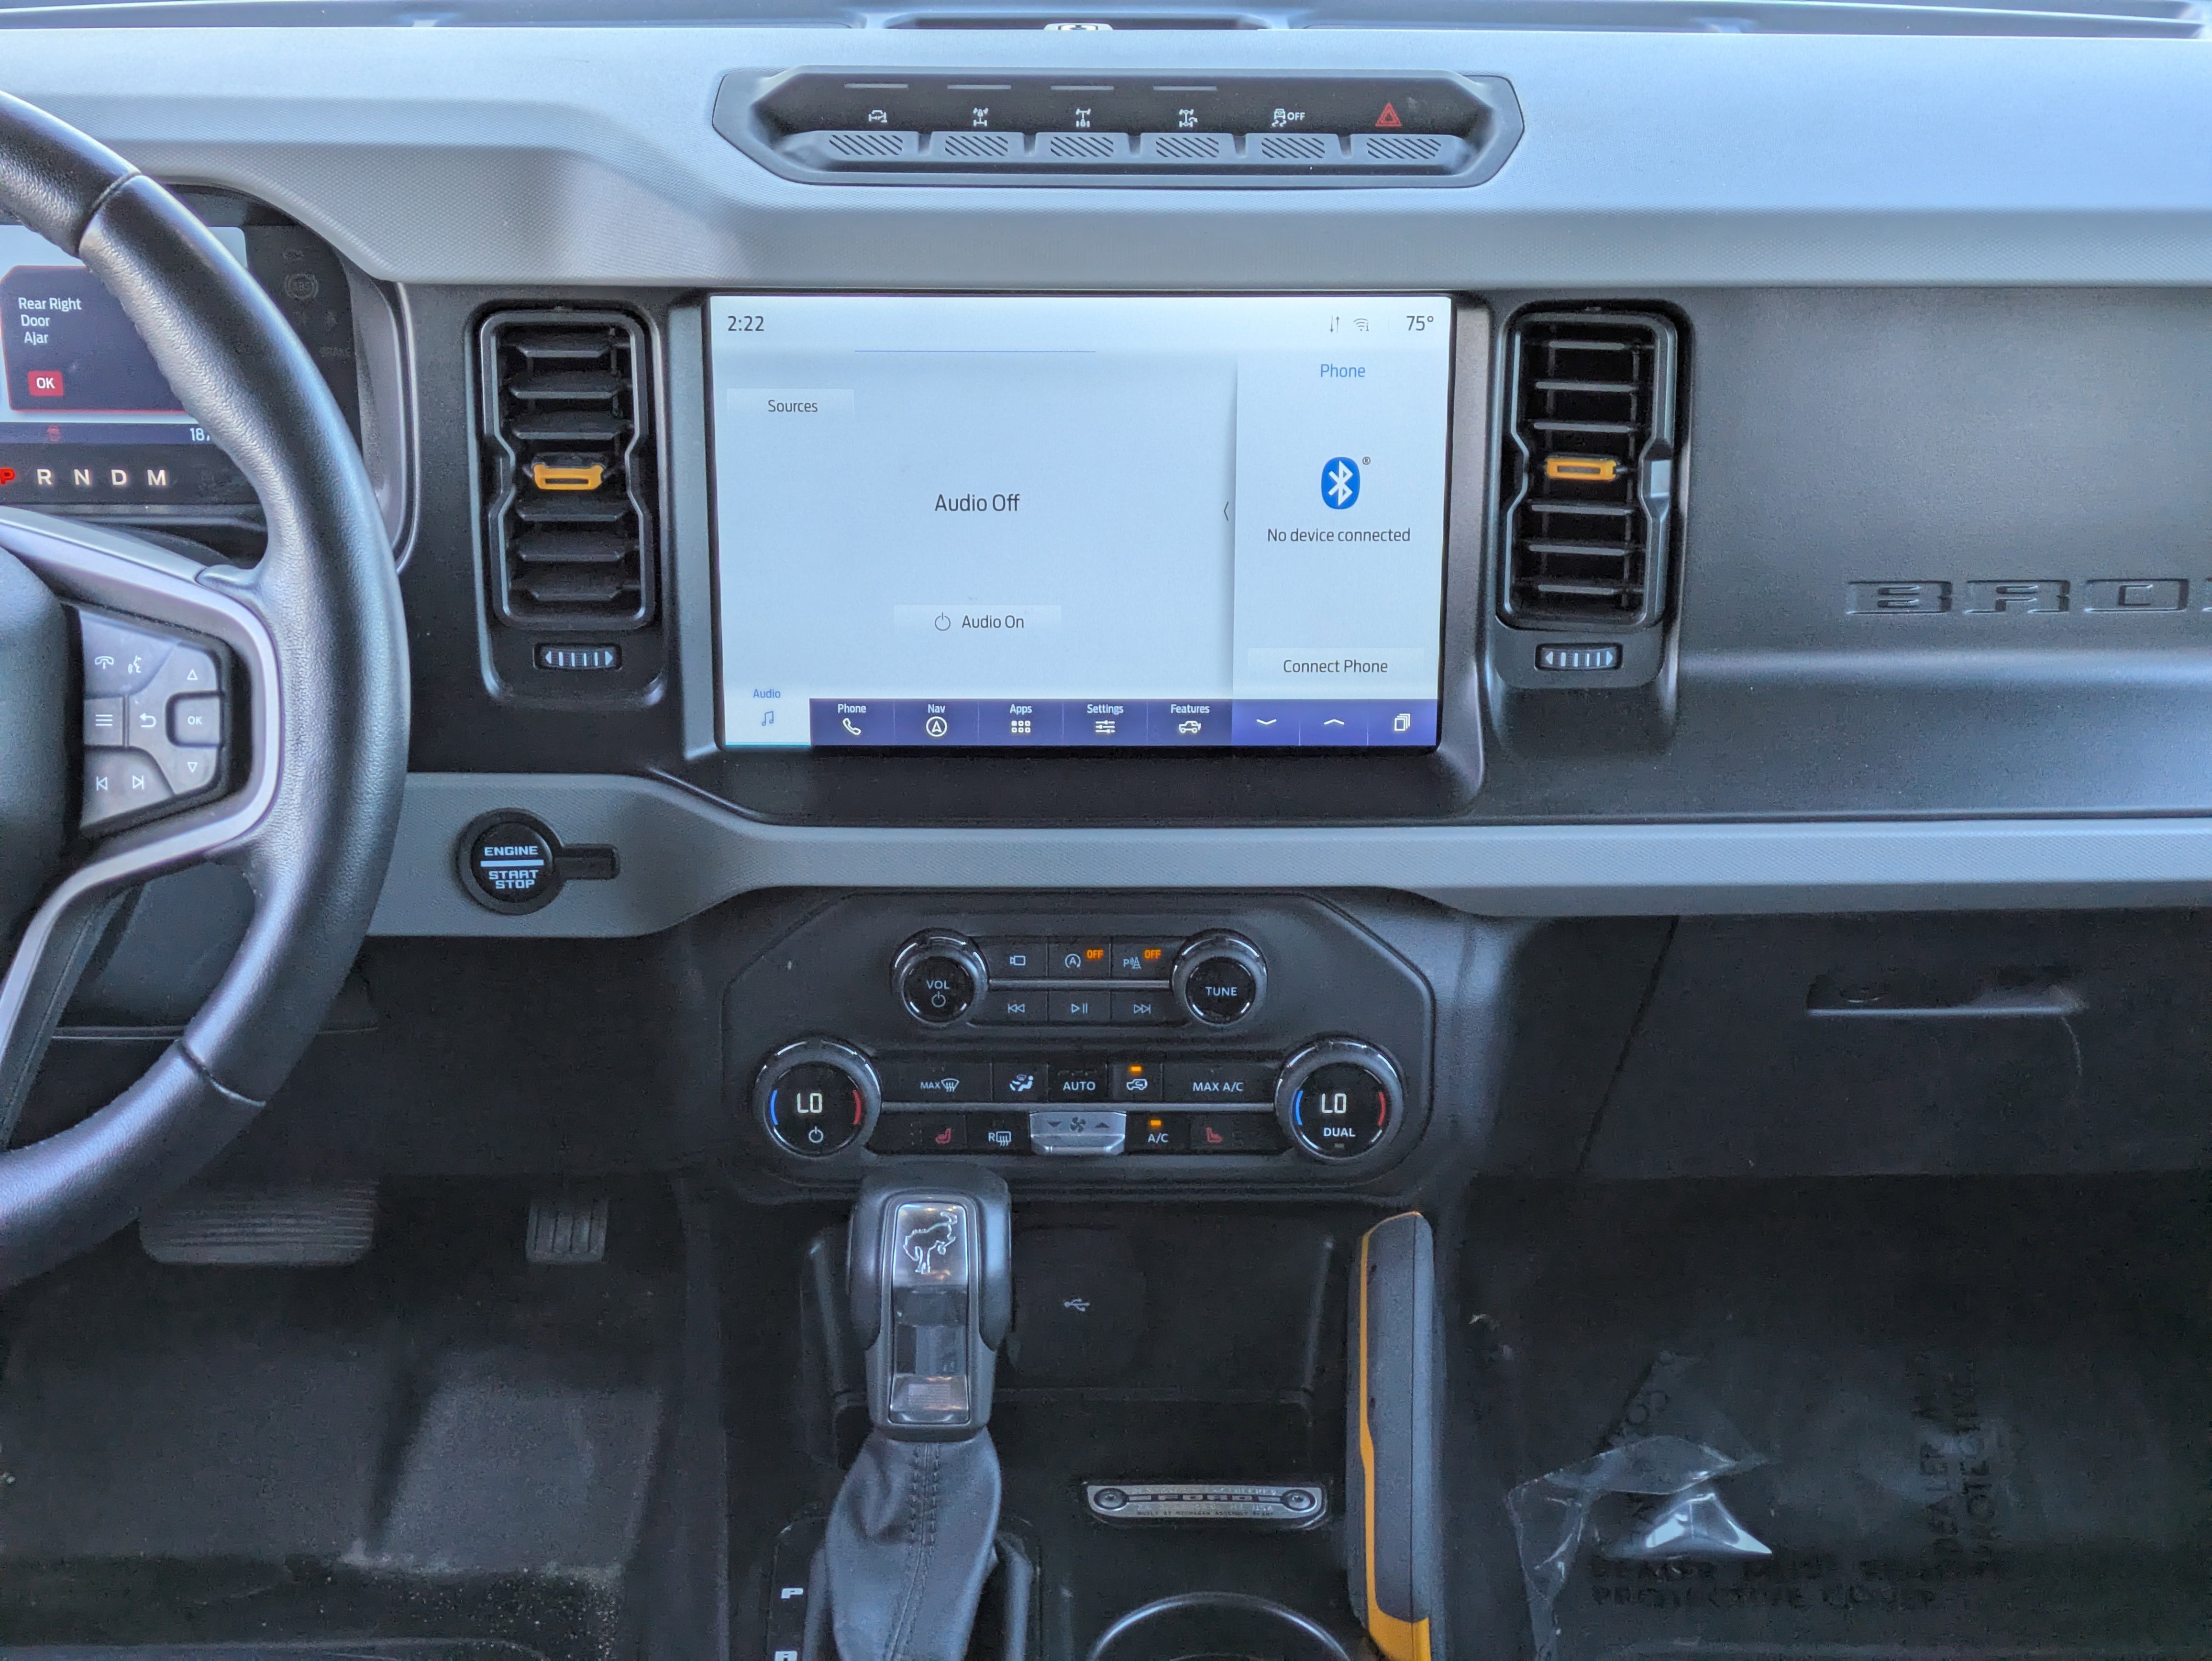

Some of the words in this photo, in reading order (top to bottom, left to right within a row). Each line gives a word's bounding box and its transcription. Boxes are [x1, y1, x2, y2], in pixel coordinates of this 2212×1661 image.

[1287, 112, 1305, 120] OFF
[19, 298, 46, 309] Rear
[49, 298, 81, 311] Right
[21, 314, 50, 326] Door
[728, 316, 764, 331] 2:22
[24, 332, 48, 345] Ajar
[1321, 364, 1365, 377] Phone
[37, 377, 55, 388] OK
[768, 400, 818, 412] Sources
[190, 428, 210, 441] 18
[37, 469, 52, 485] R
[74, 469, 90, 485] N
[111, 470, 128, 485] D
[148, 470, 166, 486] M
[935, 494, 987, 511] Audio
[993, 494, 1019, 511] Off
[1268, 529, 1286, 541] No
[1291, 529, 1334, 541] device
[1338, 528, 1410, 541] connected
[1847, 577, 2212, 615] BRO
[962, 615, 1001, 628] Audio
[1005, 615, 1024, 628] On
[1284, 660, 1339, 672] Connect
[1344, 660, 1387, 672] Phone
[753, 689, 780, 698] Audio
[838, 704, 866, 713] Phone
[928, 704, 945, 713] Nav
[1010, 704, 1032, 715] Apps
[1087, 704, 1123, 715] Settings
[1171, 704, 1209, 713] Features
[188, 716, 202, 725] OK
[485, 846, 538, 856] ENGINE
[489, 870, 539, 879] START
[496, 879, 535, 889] STOP
[1087, 950, 1103, 959] OFF
[1145, 950, 1161, 959] OFF
[927, 980, 950, 989] VOL
[1206, 987, 1237, 996] TUNE
[1063, 1082, 1095, 1090] AUTO
[1193, 1082, 1219, 1091] MAX
[1223, 1082, 1243, 1092] A/C
[1324, 1128, 1355, 1137] DUAL
[1148, 1133, 1168, 1143] A/C
[781, 1588, 803, 1599] P
